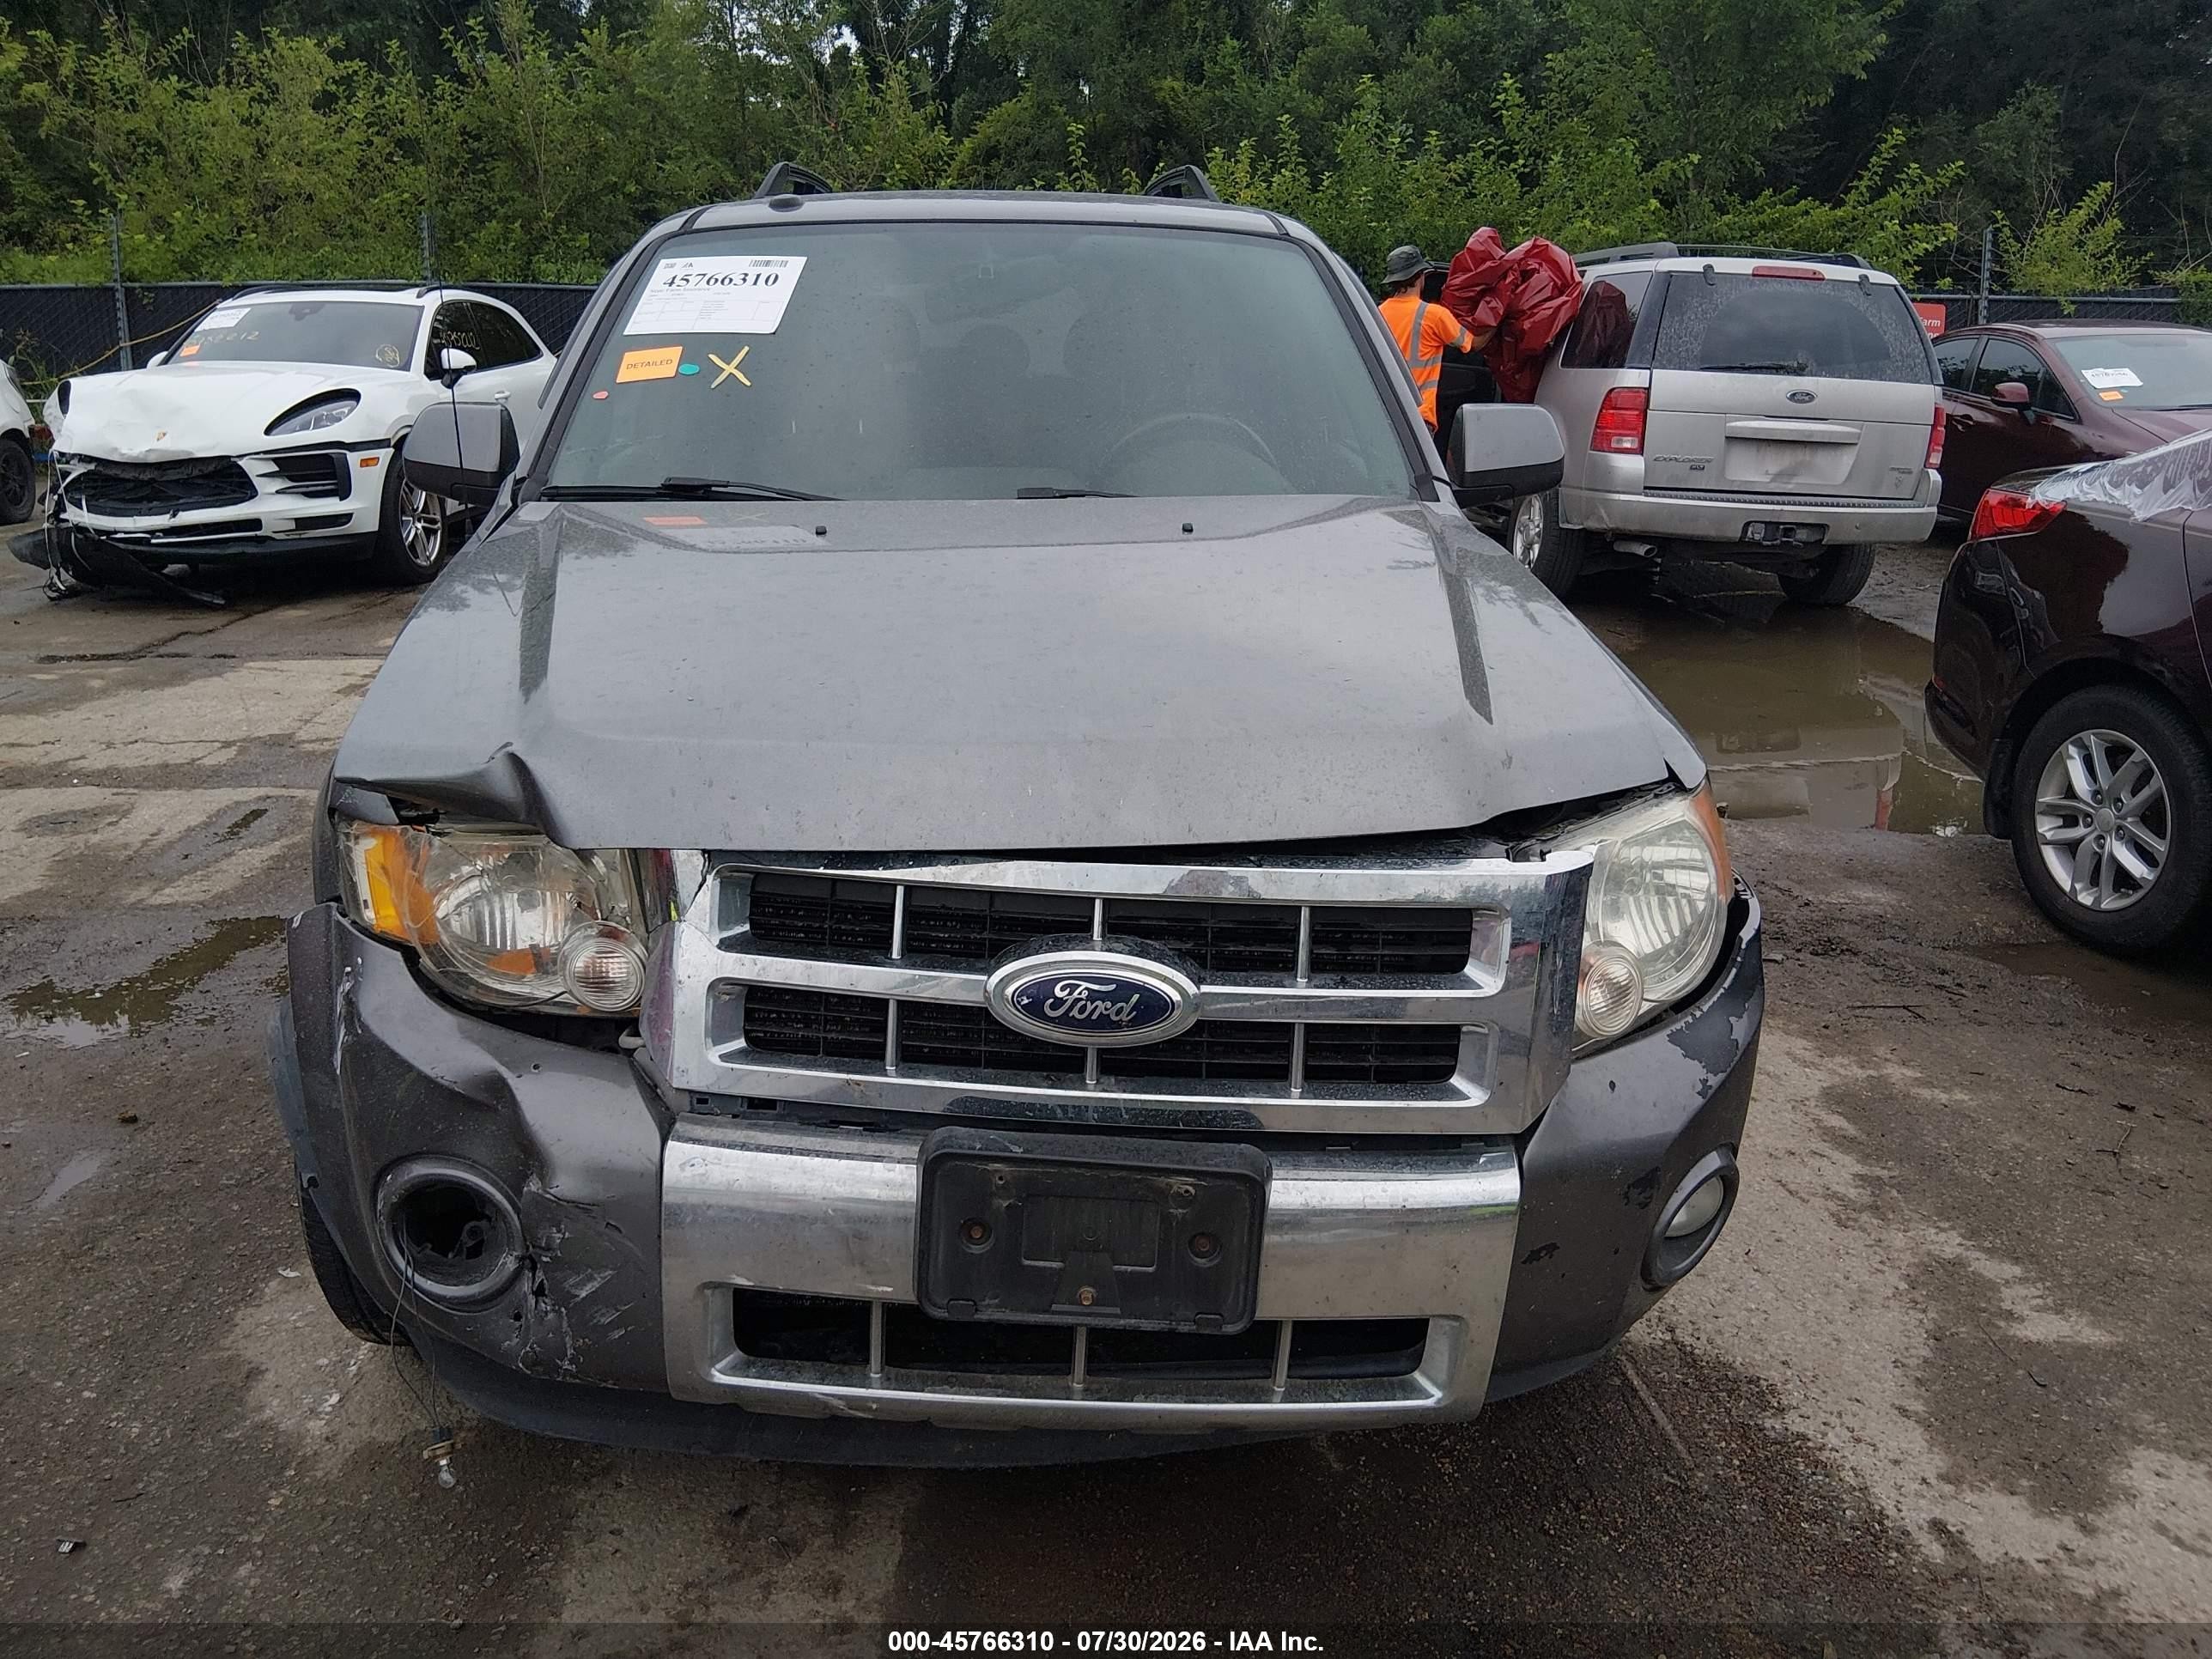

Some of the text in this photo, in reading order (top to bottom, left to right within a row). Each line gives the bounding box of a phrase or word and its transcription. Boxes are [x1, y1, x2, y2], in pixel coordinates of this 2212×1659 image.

[663, 272, 779, 288] 45766310
[1920, 317, 1941, 327] arm
[626, 358, 673, 371] DETAILED
[1043, 980, 1139, 1022] Ford
